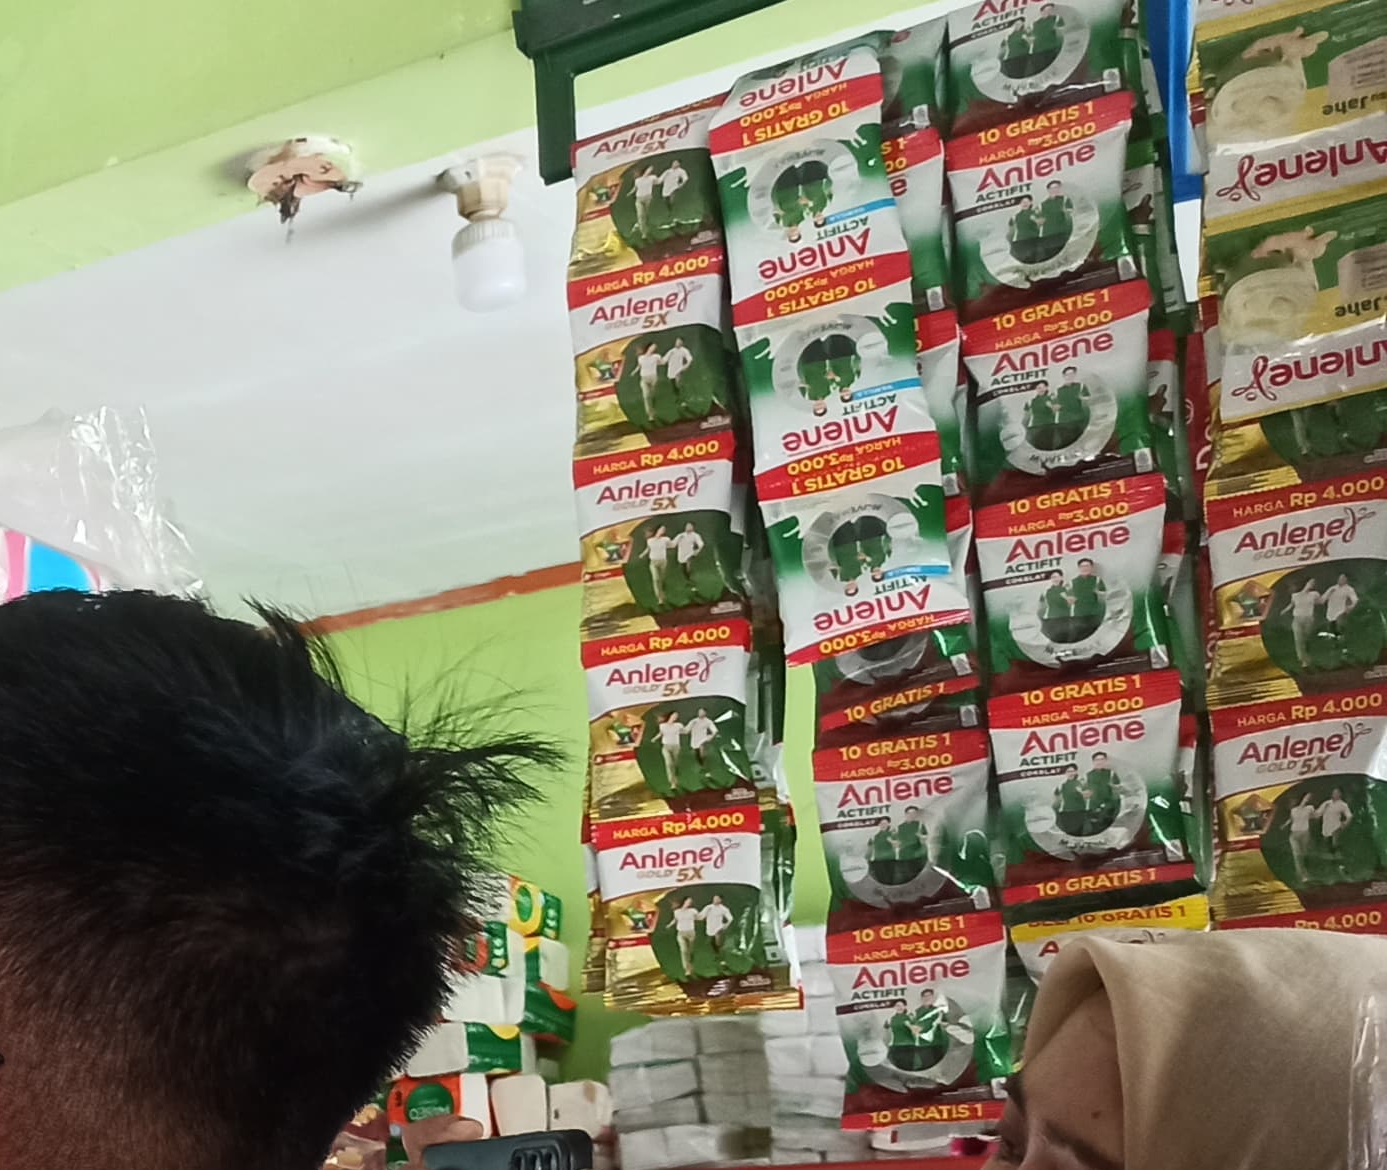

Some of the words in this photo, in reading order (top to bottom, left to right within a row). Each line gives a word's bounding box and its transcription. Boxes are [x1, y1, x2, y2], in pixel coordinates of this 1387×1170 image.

[1322, 96, 1365, 116] Jahe
[1254, 138, 1387, 186] Anlene
[817, 216, 869, 241] ACTIFIT
[758, 227, 871, 280] Anlene
[587, 279, 629, 296] HARGA
[632, 272, 655, 287] Rp
[659, 255, 709, 278] 4.000
[830, 259, 875, 278] HARGA
[778, 284, 849, 315] GRATIS
[854, 277, 876, 294] 10
[590, 294, 678, 325] Anlene
[766, 304, 774, 318] 1
[993, 316, 1015, 331] 10
[1021, 293, 1097, 323] GRATIS
[1101, 289, 1110, 302] 1
[991, 332, 1114, 376] Anlene
[995, 333, 1041, 350] HARGA
[991, 368, 1048, 386] ACTIFIT
[594, 460, 637, 475] HARGA
[640, 453, 664, 468] Rp
[667, 440, 719, 462] 4.000
[597, 478, 687, 505] Anlene
[650, 496, 677, 511] 5X
[813, 584, 931, 632] Anlene
[1021, 691, 1043, 706] 10
[1050, 678, 1127, 700] GRATIS
[1132, 675, 1141, 688] 1
[1022, 712, 1069, 727] HARGA
[1237, 712, 1286, 728] HARGA
[1291, 705, 1317, 720] Rp
[1322, 693, 1382, 712] 4.000
[840, 746, 859, 761] 10
[866, 736, 937, 757] GRATIS
[942, 733, 951, 747] 1
[1020, 720, 1145, 756] Anlene
[1237, 728, 1343, 766] Anlene
[1020, 752, 1077, 767] ACTIFIT
[1298, 754, 1330, 776] 5X
[837, 774, 954, 809] Anlene
[837, 804, 891, 818] ACTIFIT
[613, 825, 658, 840] HARGA
[661, 820, 686, 835] Rp
[687, 812, 744, 830] 4.000
[619, 845, 712, 871] Anlene
